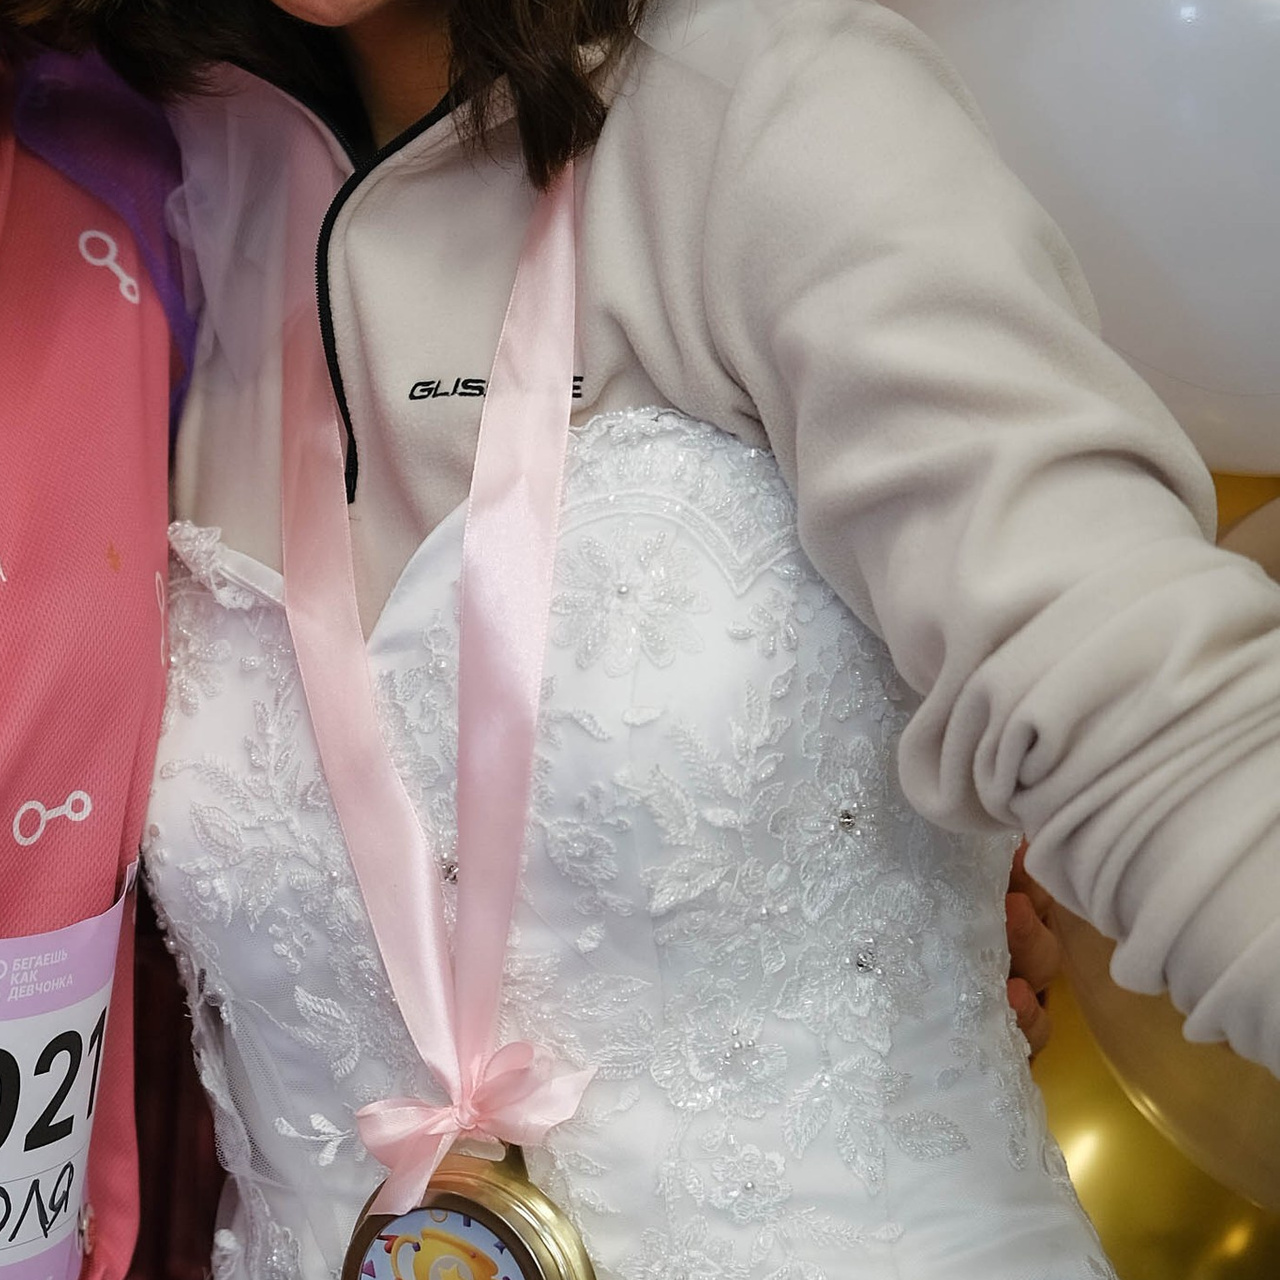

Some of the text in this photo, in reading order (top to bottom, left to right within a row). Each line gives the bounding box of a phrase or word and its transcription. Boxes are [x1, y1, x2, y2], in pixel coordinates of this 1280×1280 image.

[409, 375, 584, 401] GLISE
[11, 947, 69, 971] БЕГАЕШЬ
[7, 974, 74, 1003] ДЕВЧОНКА
[10, 969, 38, 986] КАК
